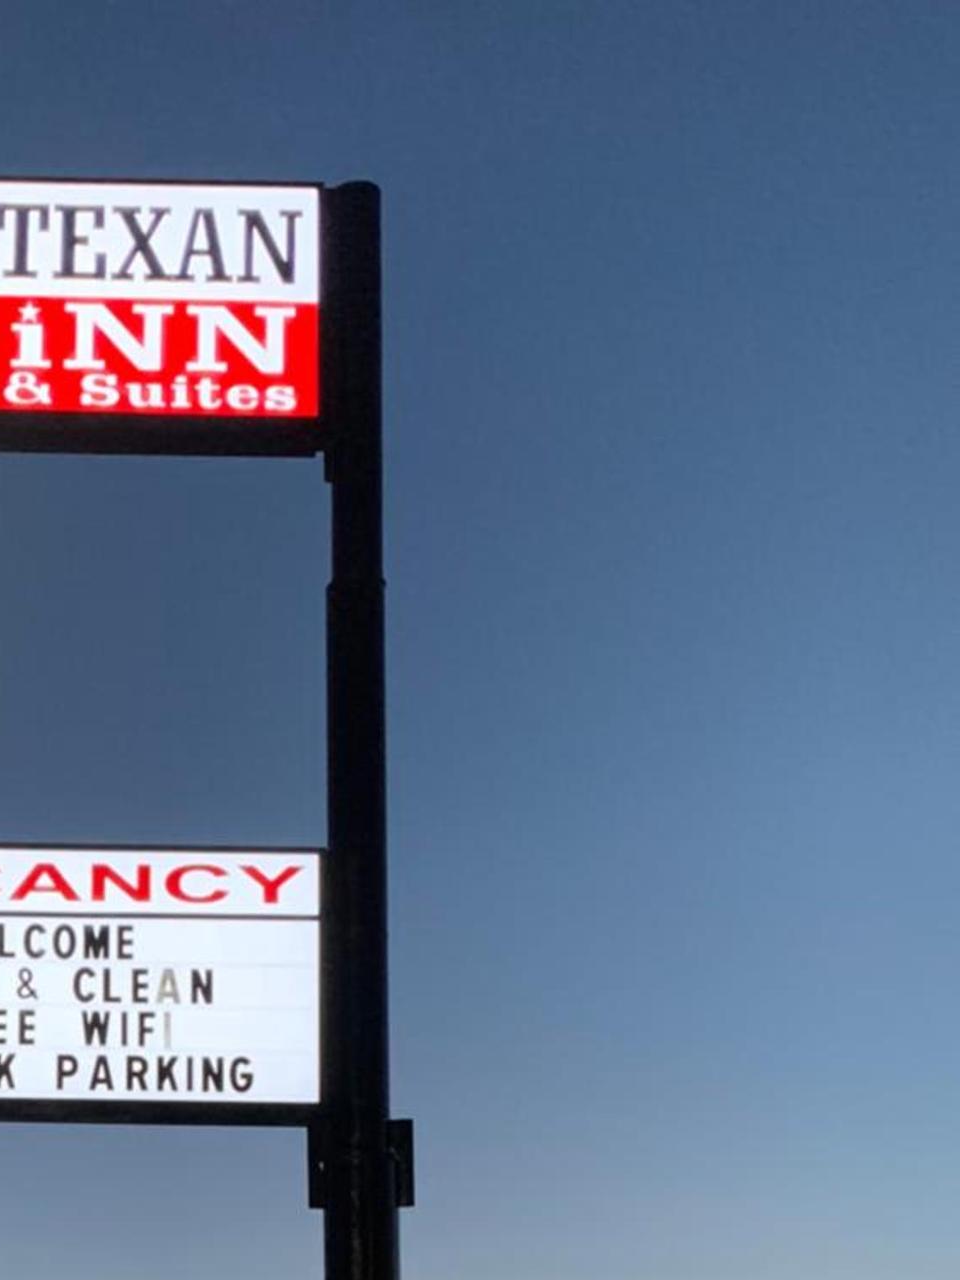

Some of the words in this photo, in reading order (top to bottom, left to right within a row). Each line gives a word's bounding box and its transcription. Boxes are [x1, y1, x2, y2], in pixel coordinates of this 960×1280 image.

[3, 371, 51, 406] &
[80, 373, 297, 411] Suites
[16, 968, 39, 999] &
[73, 967, 214, 1004] CLEAN
[81, 1010, 172, 1049] WIFI
[56, 1055, 254, 1093] PARKING
